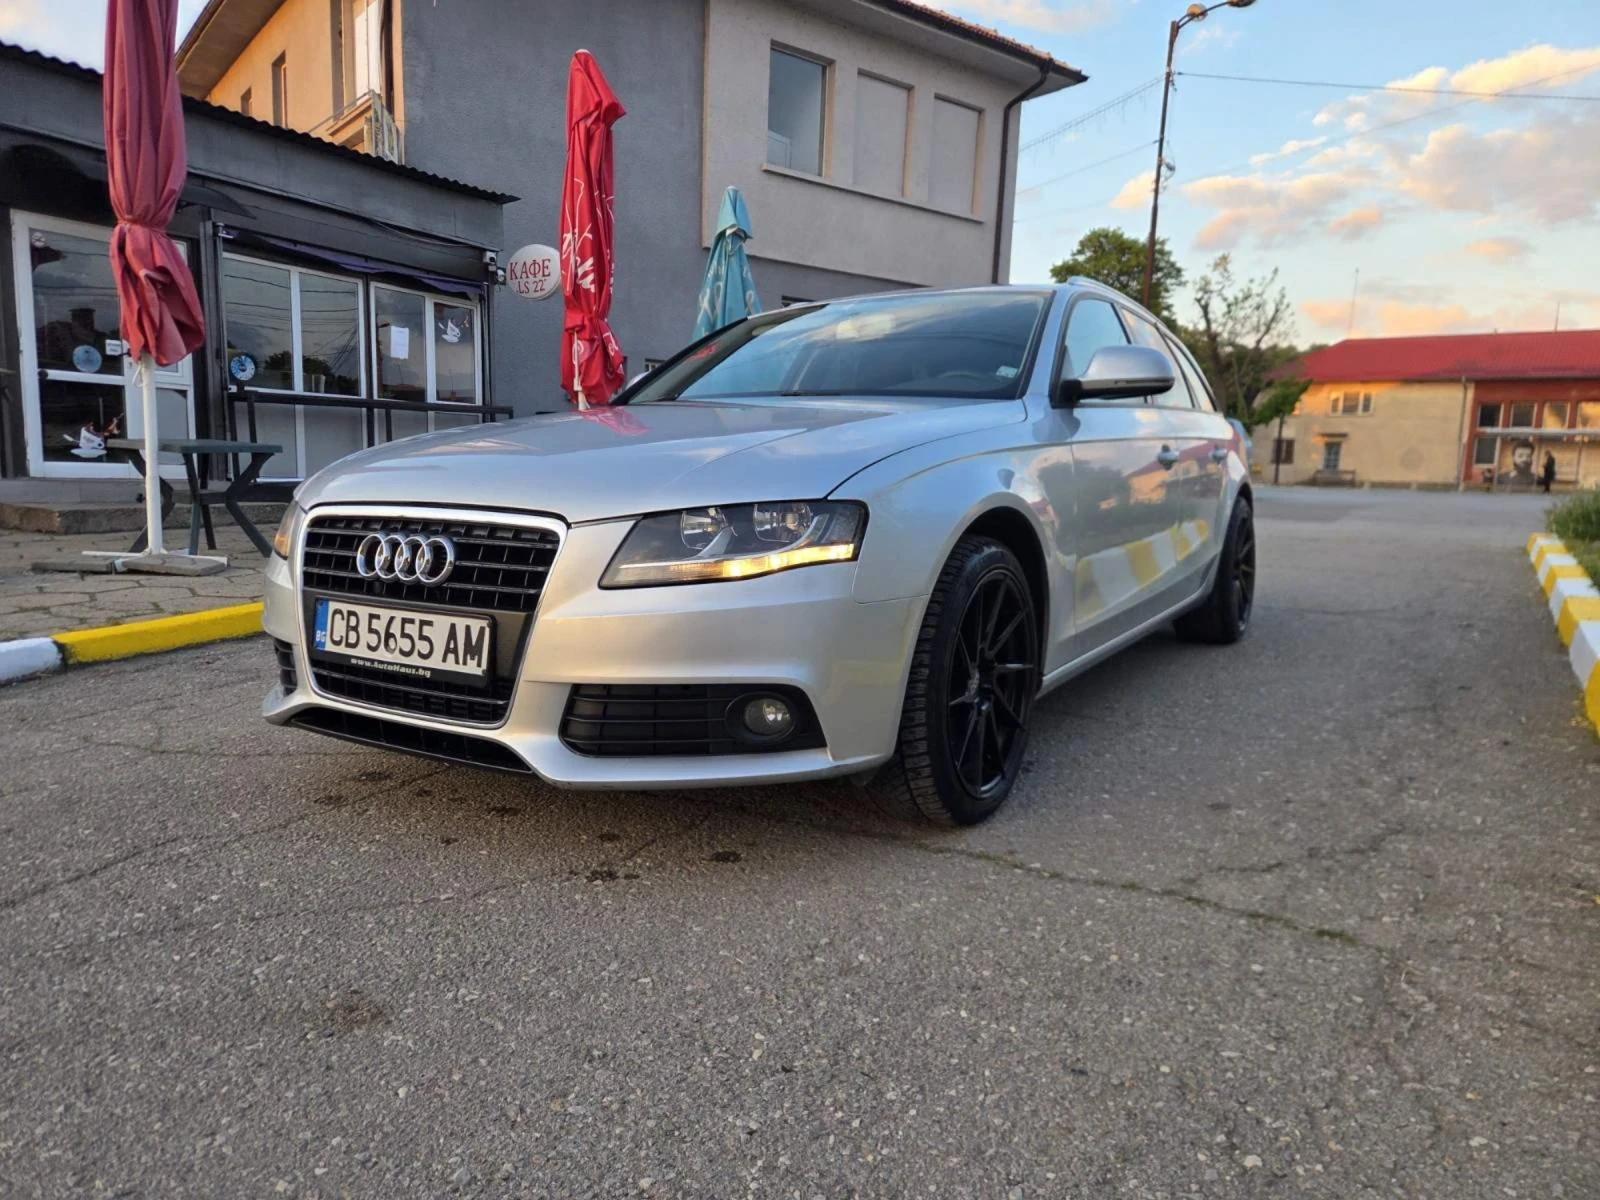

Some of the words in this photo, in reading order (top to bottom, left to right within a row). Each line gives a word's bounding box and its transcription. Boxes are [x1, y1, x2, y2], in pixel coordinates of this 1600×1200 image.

[510, 258, 551, 280] КАФЕ
[315, 630, 326, 642] BG
[329, 608, 360, 649] CB
[366, 612, 434, 660] 5655
[441, 622, 486, 668] AM
[350, 657, 431, 678] www.AutoHaus.bg
